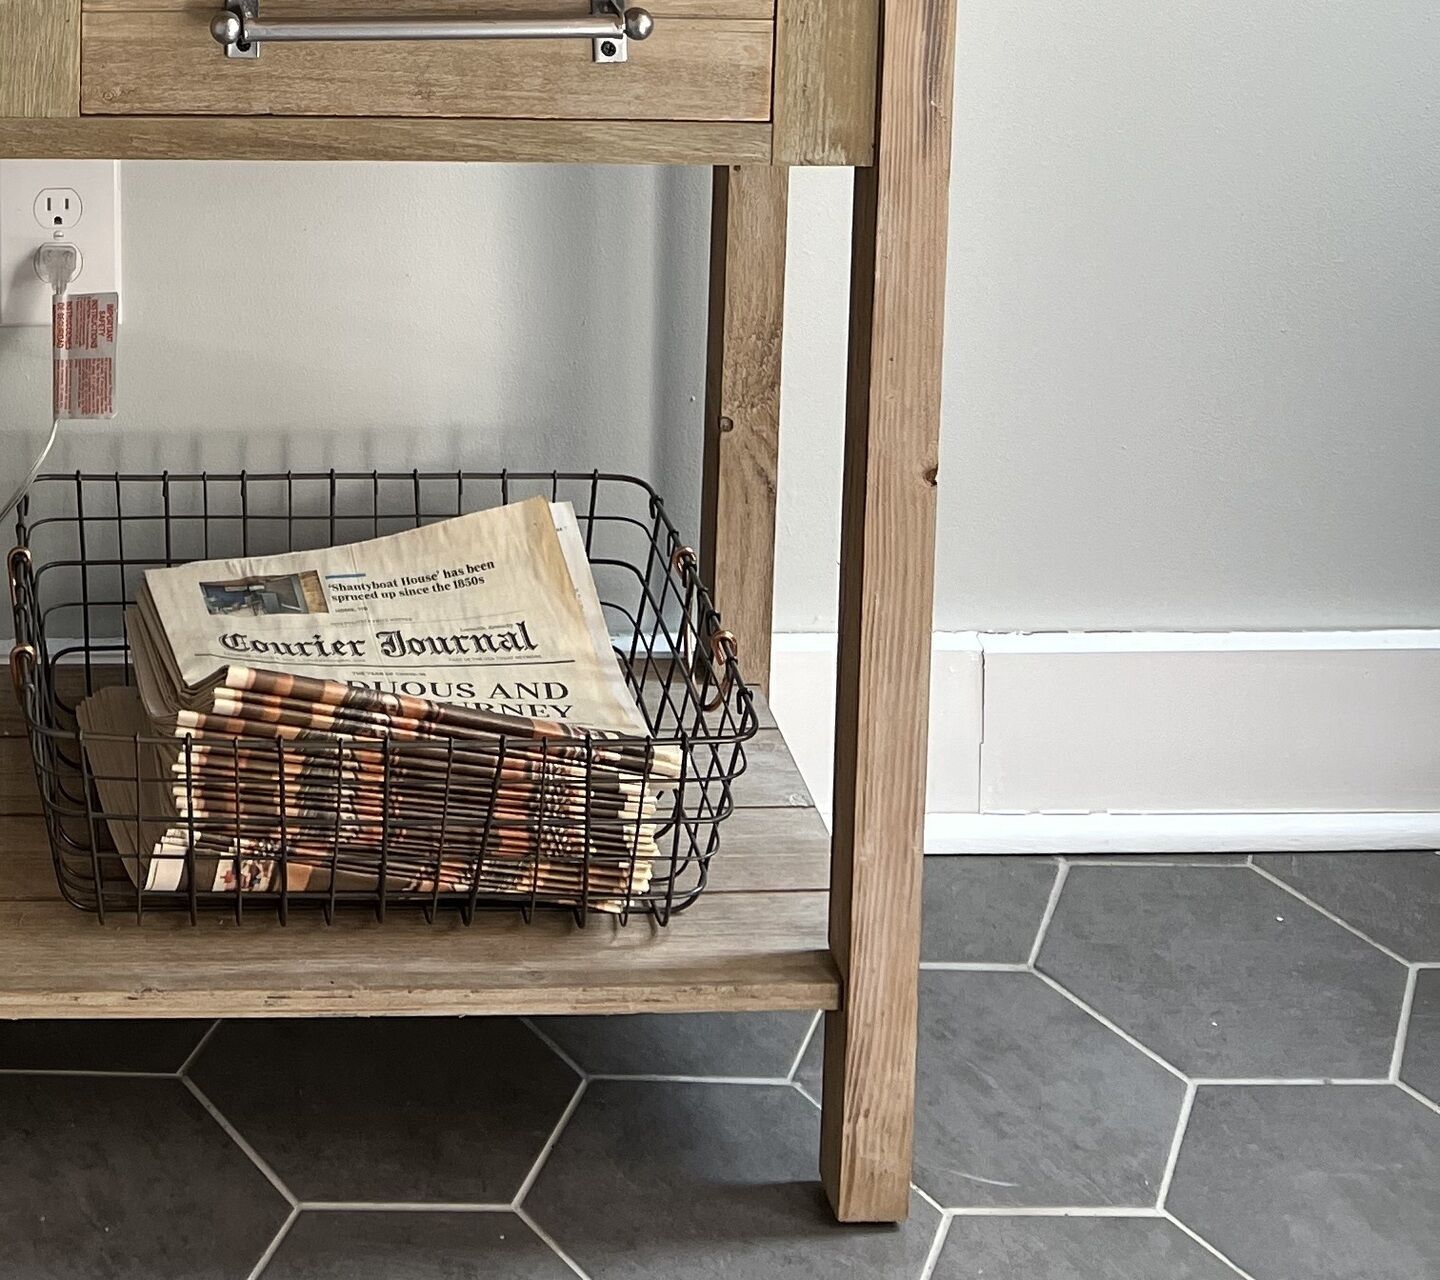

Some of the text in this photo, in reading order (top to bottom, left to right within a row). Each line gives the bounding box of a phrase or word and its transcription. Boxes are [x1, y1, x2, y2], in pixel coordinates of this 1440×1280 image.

[90, 299, 98, 349] INSTRUCTIONS
[106, 303, 114, 343] IMPORTANT
[443, 568, 465, 579] has
[466, 560, 496, 575] been
[331, 575, 486, 603] spruced up since the 1850s
[218, 632, 366, 658] Courier
[375, 620, 539, 659] Journal
[489, 682, 570, 701] AND
